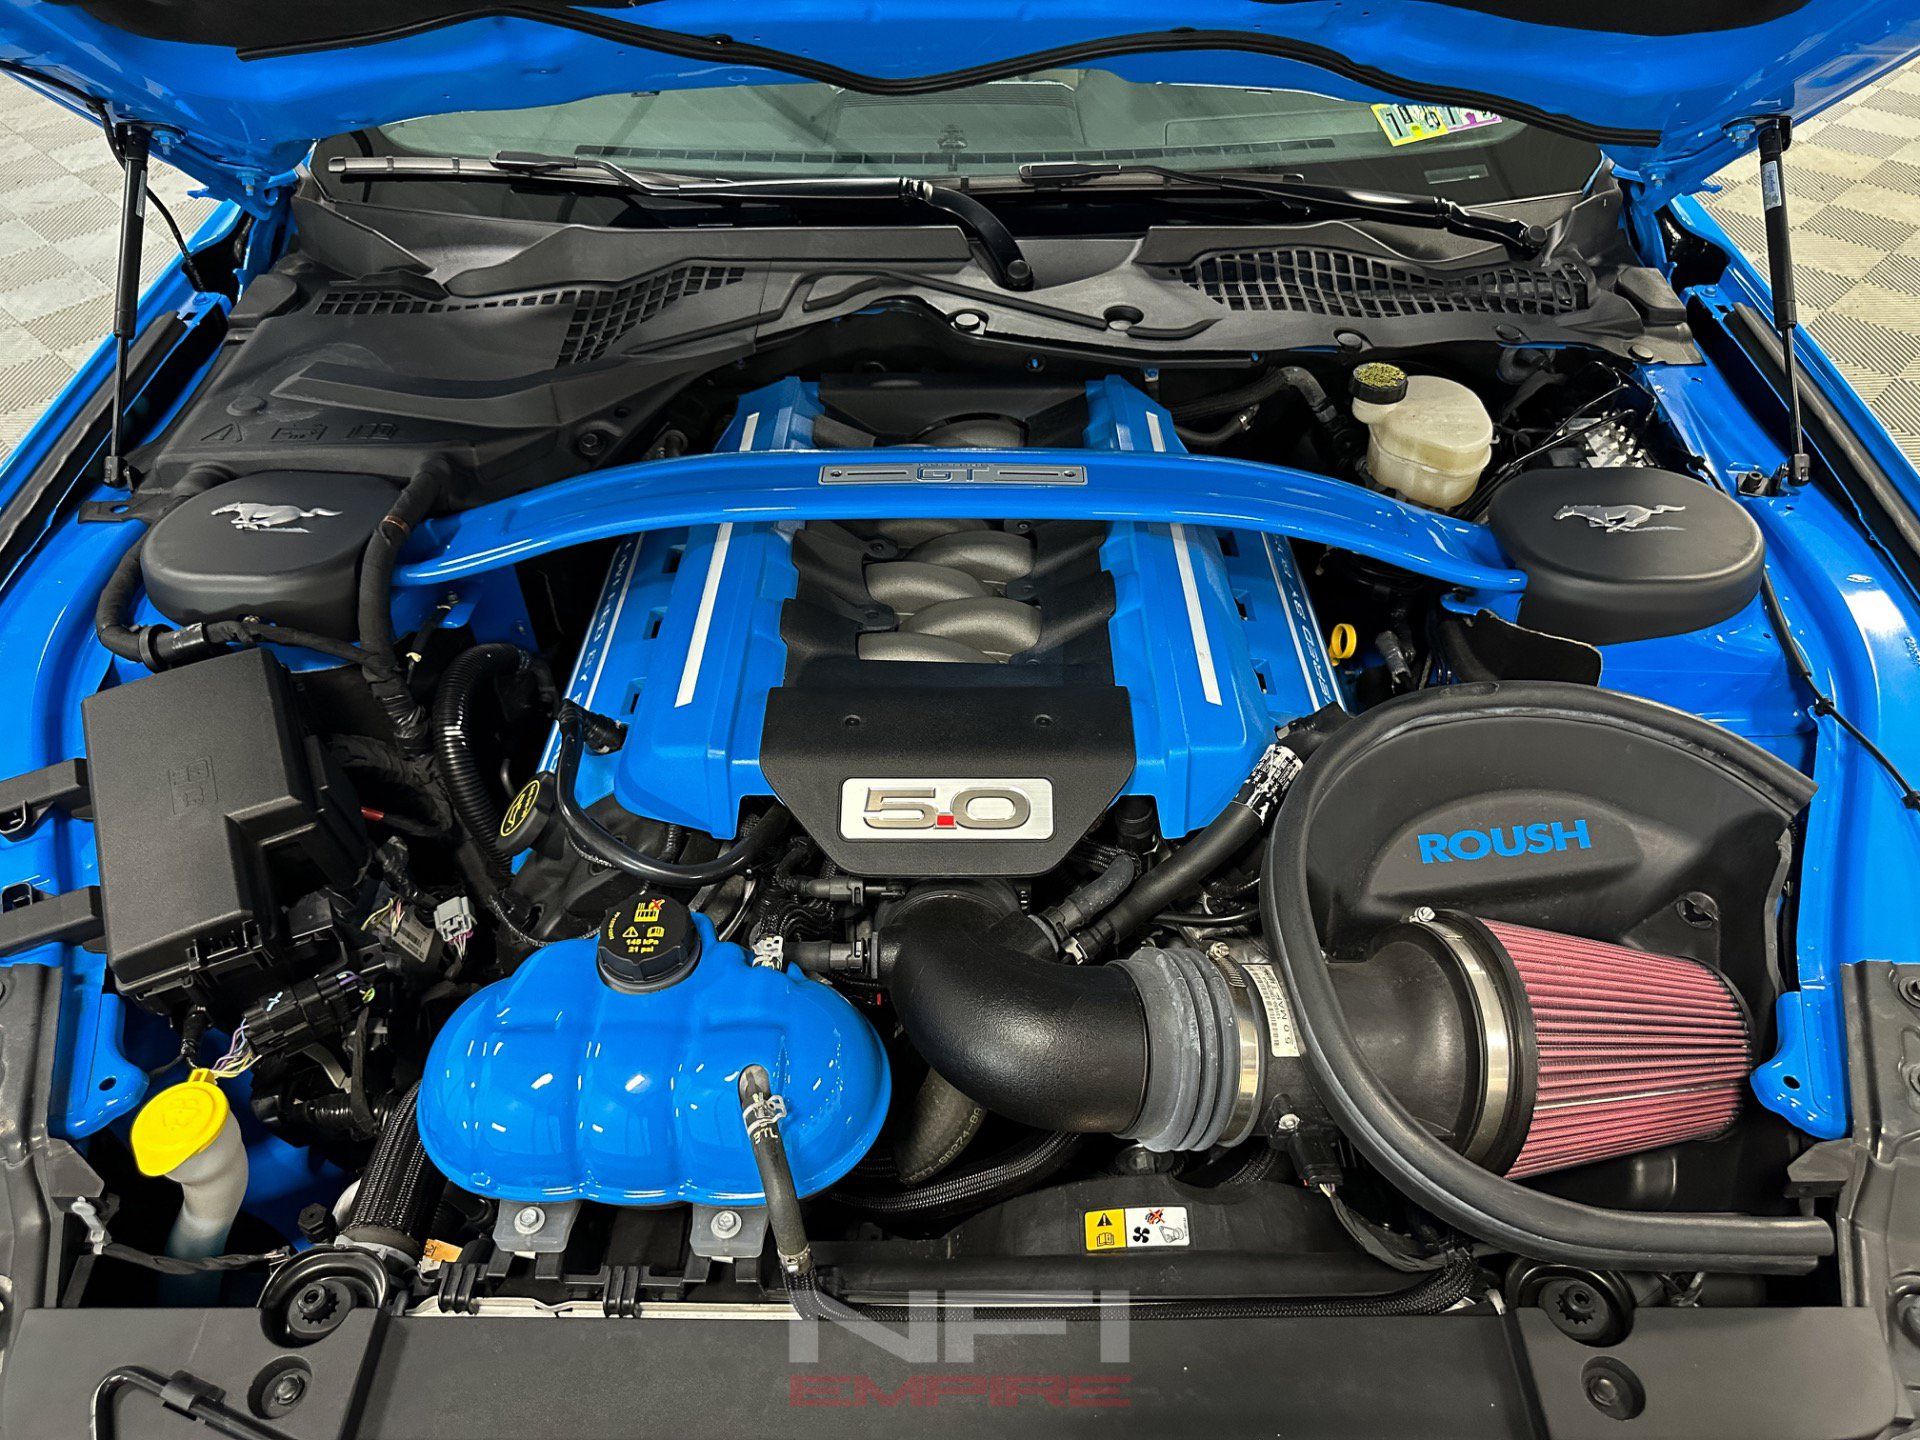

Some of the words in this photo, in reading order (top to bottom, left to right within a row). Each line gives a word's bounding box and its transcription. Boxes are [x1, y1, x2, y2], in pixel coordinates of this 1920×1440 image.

[916, 465, 990, 482] GT
[863, 786, 1032, 830] 5.0
[1418, 819, 1592, 864] ROUSH
